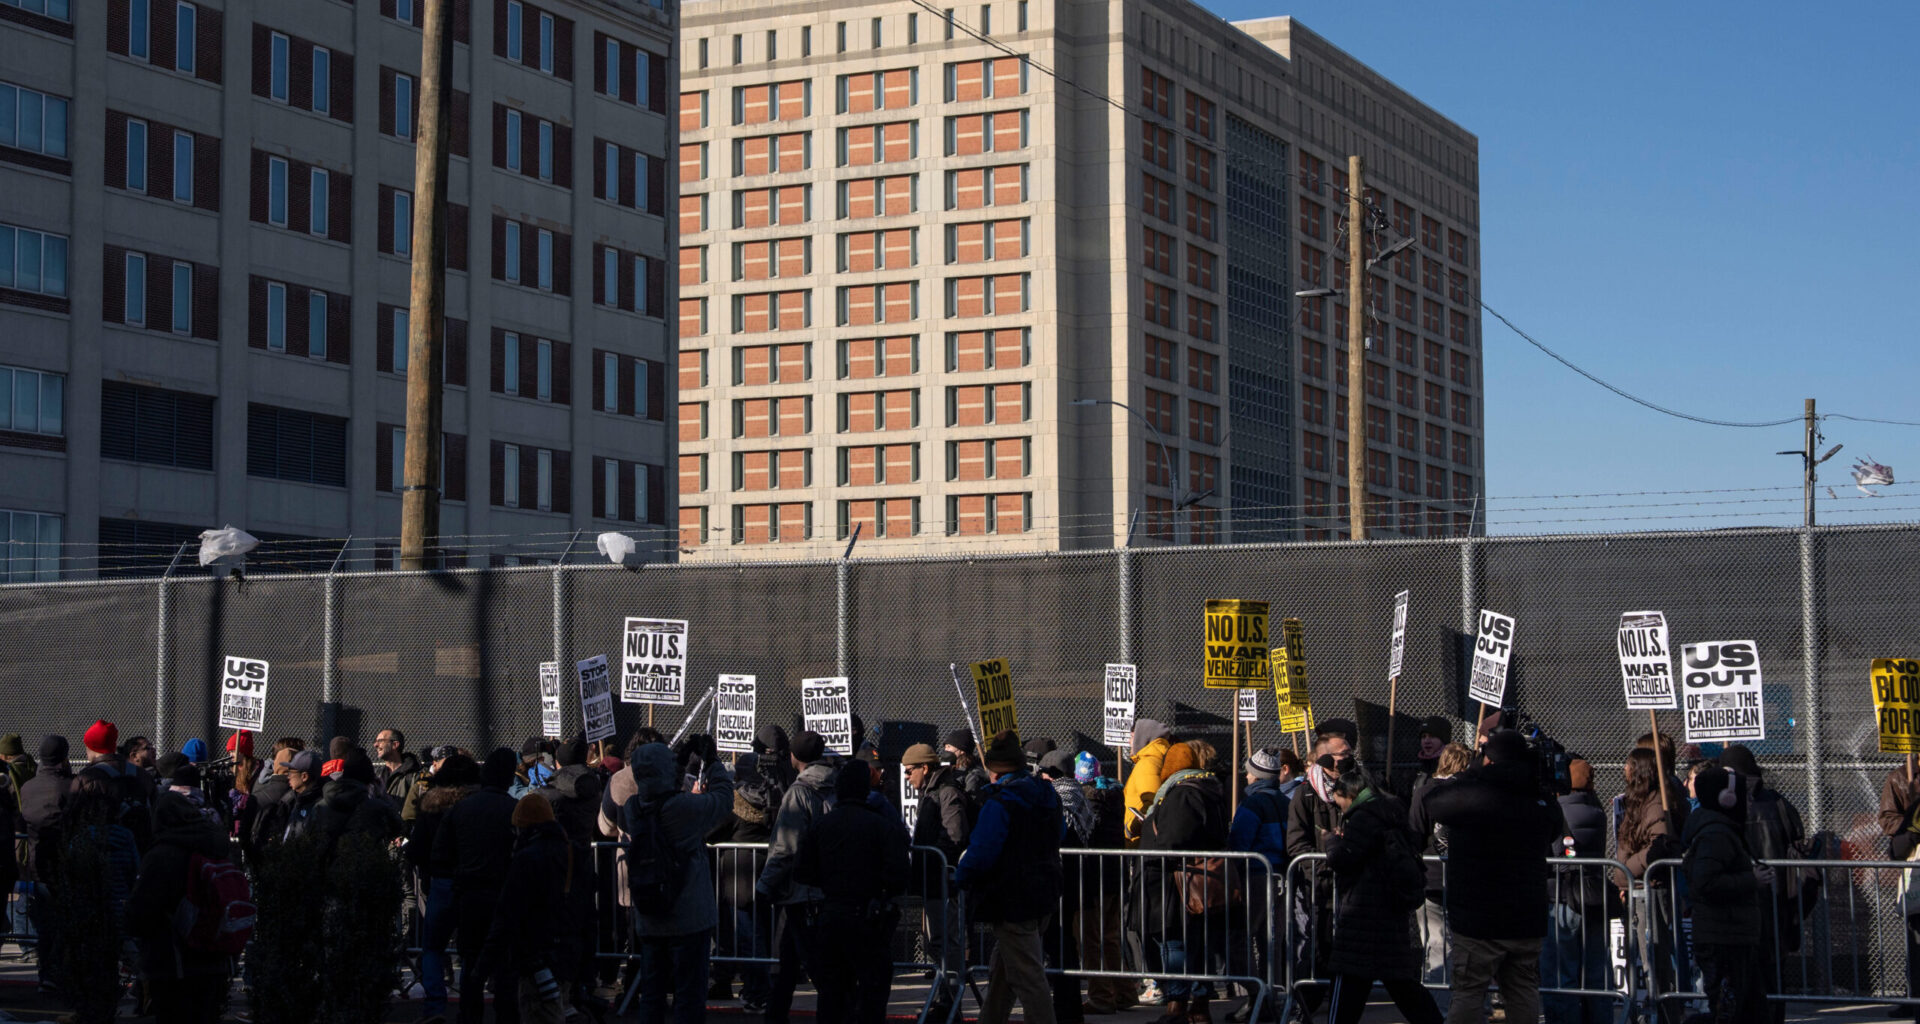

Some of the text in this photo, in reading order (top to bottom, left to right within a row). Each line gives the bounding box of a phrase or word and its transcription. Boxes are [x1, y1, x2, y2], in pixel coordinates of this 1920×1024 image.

[1207, 614, 1267, 643] NO U.S.
[1481, 613, 1512, 641] US
[626, 632, 683, 660] NO U.S.
[1477, 636, 1509, 658] OUT
[1619, 628, 1666, 658] NO U.S.
[1207, 645, 1267, 660] WAR
[1685, 643, 1755, 670] US
[227, 660, 266, 680] US
[581, 663, 607, 680] STOP
[625, 662, 682, 677] WAR
[979, 661, 1002, 676] NO
[1207, 659, 1267, 678] VENEZUELA
[1274, 663, 1289, 690] NEE
[1288, 665, 1305, 676] NO
[1494, 662, 1506, 679] THE
[1623, 662, 1669, 677] WAR
[1885, 660, 1920, 675] NO
[225, 677, 265, 693] OUT
[625, 675, 681, 693] VENEZUELA
[1626, 677, 1672, 695] VENEZUELA
[1685, 669, 1757, 688] OUT
[719, 682, 754, 694] STOP
[803, 686, 846, 698] STOP
[977, 674, 1012, 706] BLOOD
[1106, 677, 1134, 703] NEEDS
[1876, 674, 1920, 704] BLOO
[223, 693, 263, 709] OF THE
[719, 693, 754, 711] BOMBING
[804, 697, 848, 715] BOMBING
[1240, 696, 1255, 708] OW!
[1687, 694, 1701, 710] OF
[1737, 691, 1759, 708] THE
[222, 705, 262, 721] CARIBBEAN
[981, 704, 1017, 737] FOR OIL
[1106, 707, 1128, 718] NOT
[1688, 708, 1760, 729] CARIBBEAN
[1879, 707, 1920, 736] FOR O
[718, 715, 753, 730] VENEZUELA
[806, 718, 849, 733] VENEZUELA
[718, 730, 753, 741] NOW!
[822, 733, 850, 744] OW!
[904, 778, 919, 800] BL
[904, 804, 918, 826] FO
